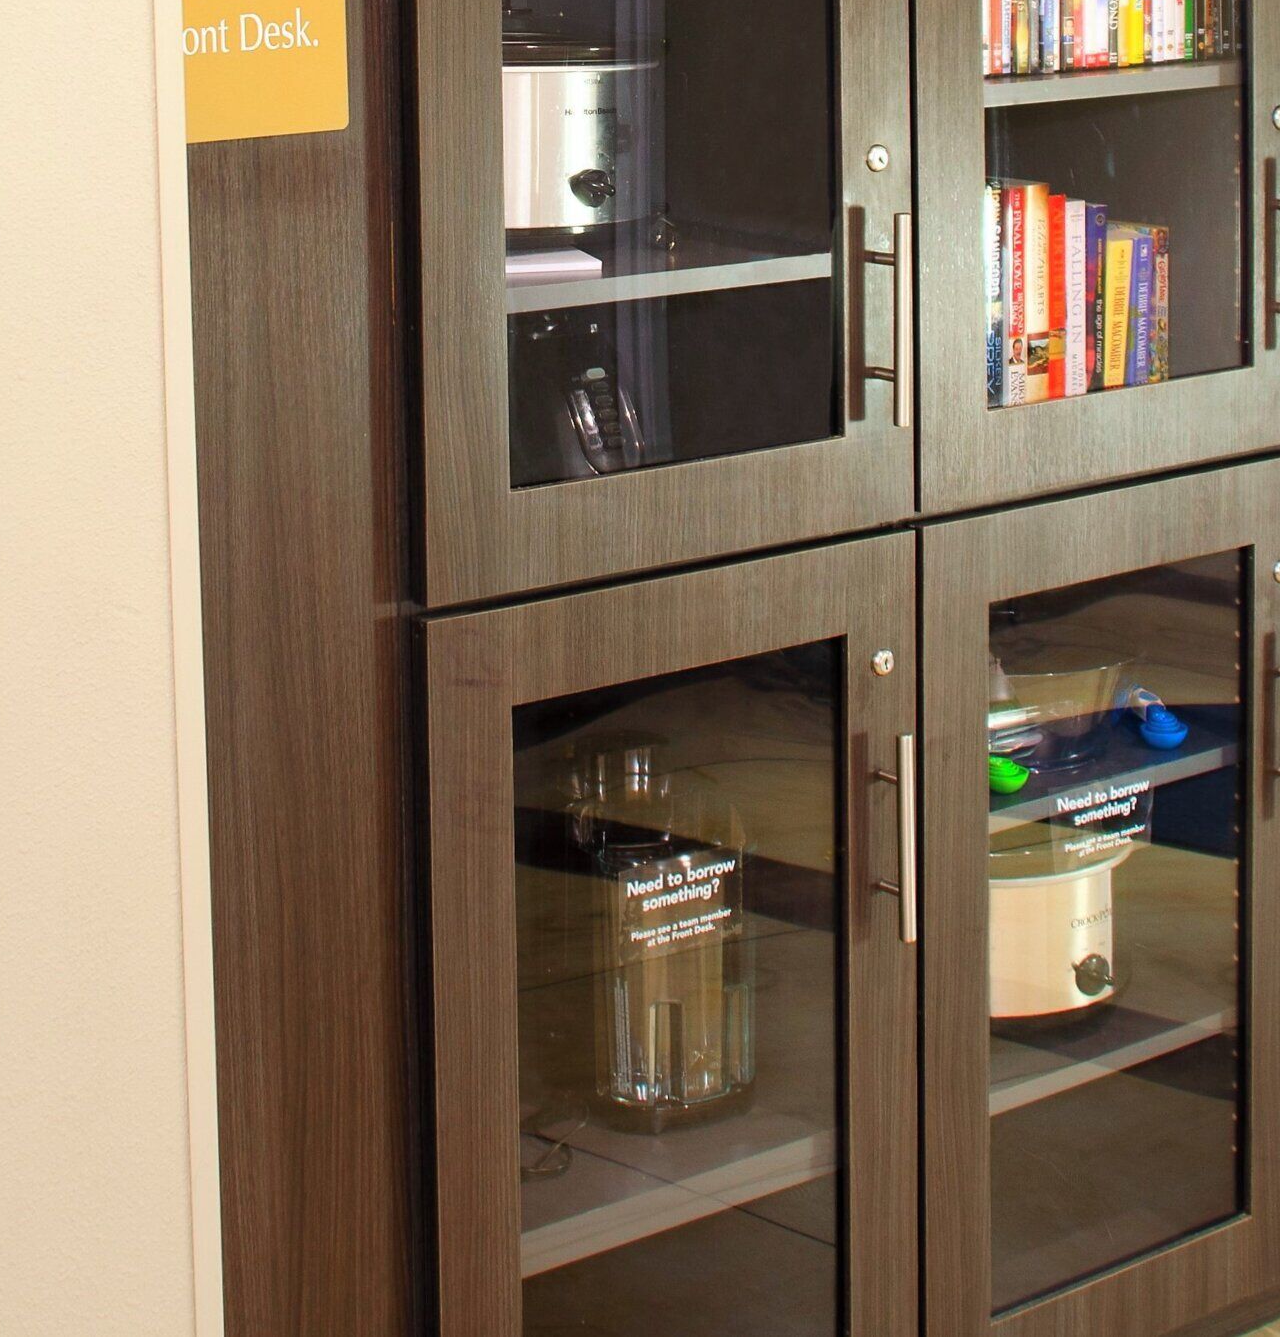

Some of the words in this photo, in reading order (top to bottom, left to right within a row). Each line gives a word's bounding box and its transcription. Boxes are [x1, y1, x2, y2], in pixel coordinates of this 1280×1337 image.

[181, 19, 230, 56] ont
[239, 8, 320, 52] Desk.
[1013, 210, 1022, 248] FINAL
[1013, 251, 1022, 290] MOVE
[1071, 235, 1082, 317] FALLING
[1096, 299, 1104, 313] the
[1112, 286, 1124, 317] DEBBIE
[1137, 283, 1148, 314] DEBBIE
[1071, 324, 1081, 343] IN
[1096, 331, 1104, 340] of
[1110, 321, 1124, 371] MACOMBER
[1136, 318, 1147, 368] MACOMBER
[1095, 340, 1104, 373] miracles
[1057, 792, 1092, 812] Need
[1094, 792, 1108, 803] to
[1110, 780, 1149, 800] borrow
[1074, 796, 1137, 826] something?
[626, 873, 664, 898] Need
[667, 873, 683, 887] to
[686, 860, 736, 882] borrow
[642, 878, 720, 912] something?
[631, 927, 656, 942] Please
[657, 925, 671, 934] see
[679, 917, 699, 928] team
[700, 908, 731, 923] member
[647, 937, 656, 947] at
[657, 933, 670, 944] the
[672, 928, 693, 940] Front
[694, 922, 716, 934] Desk.
